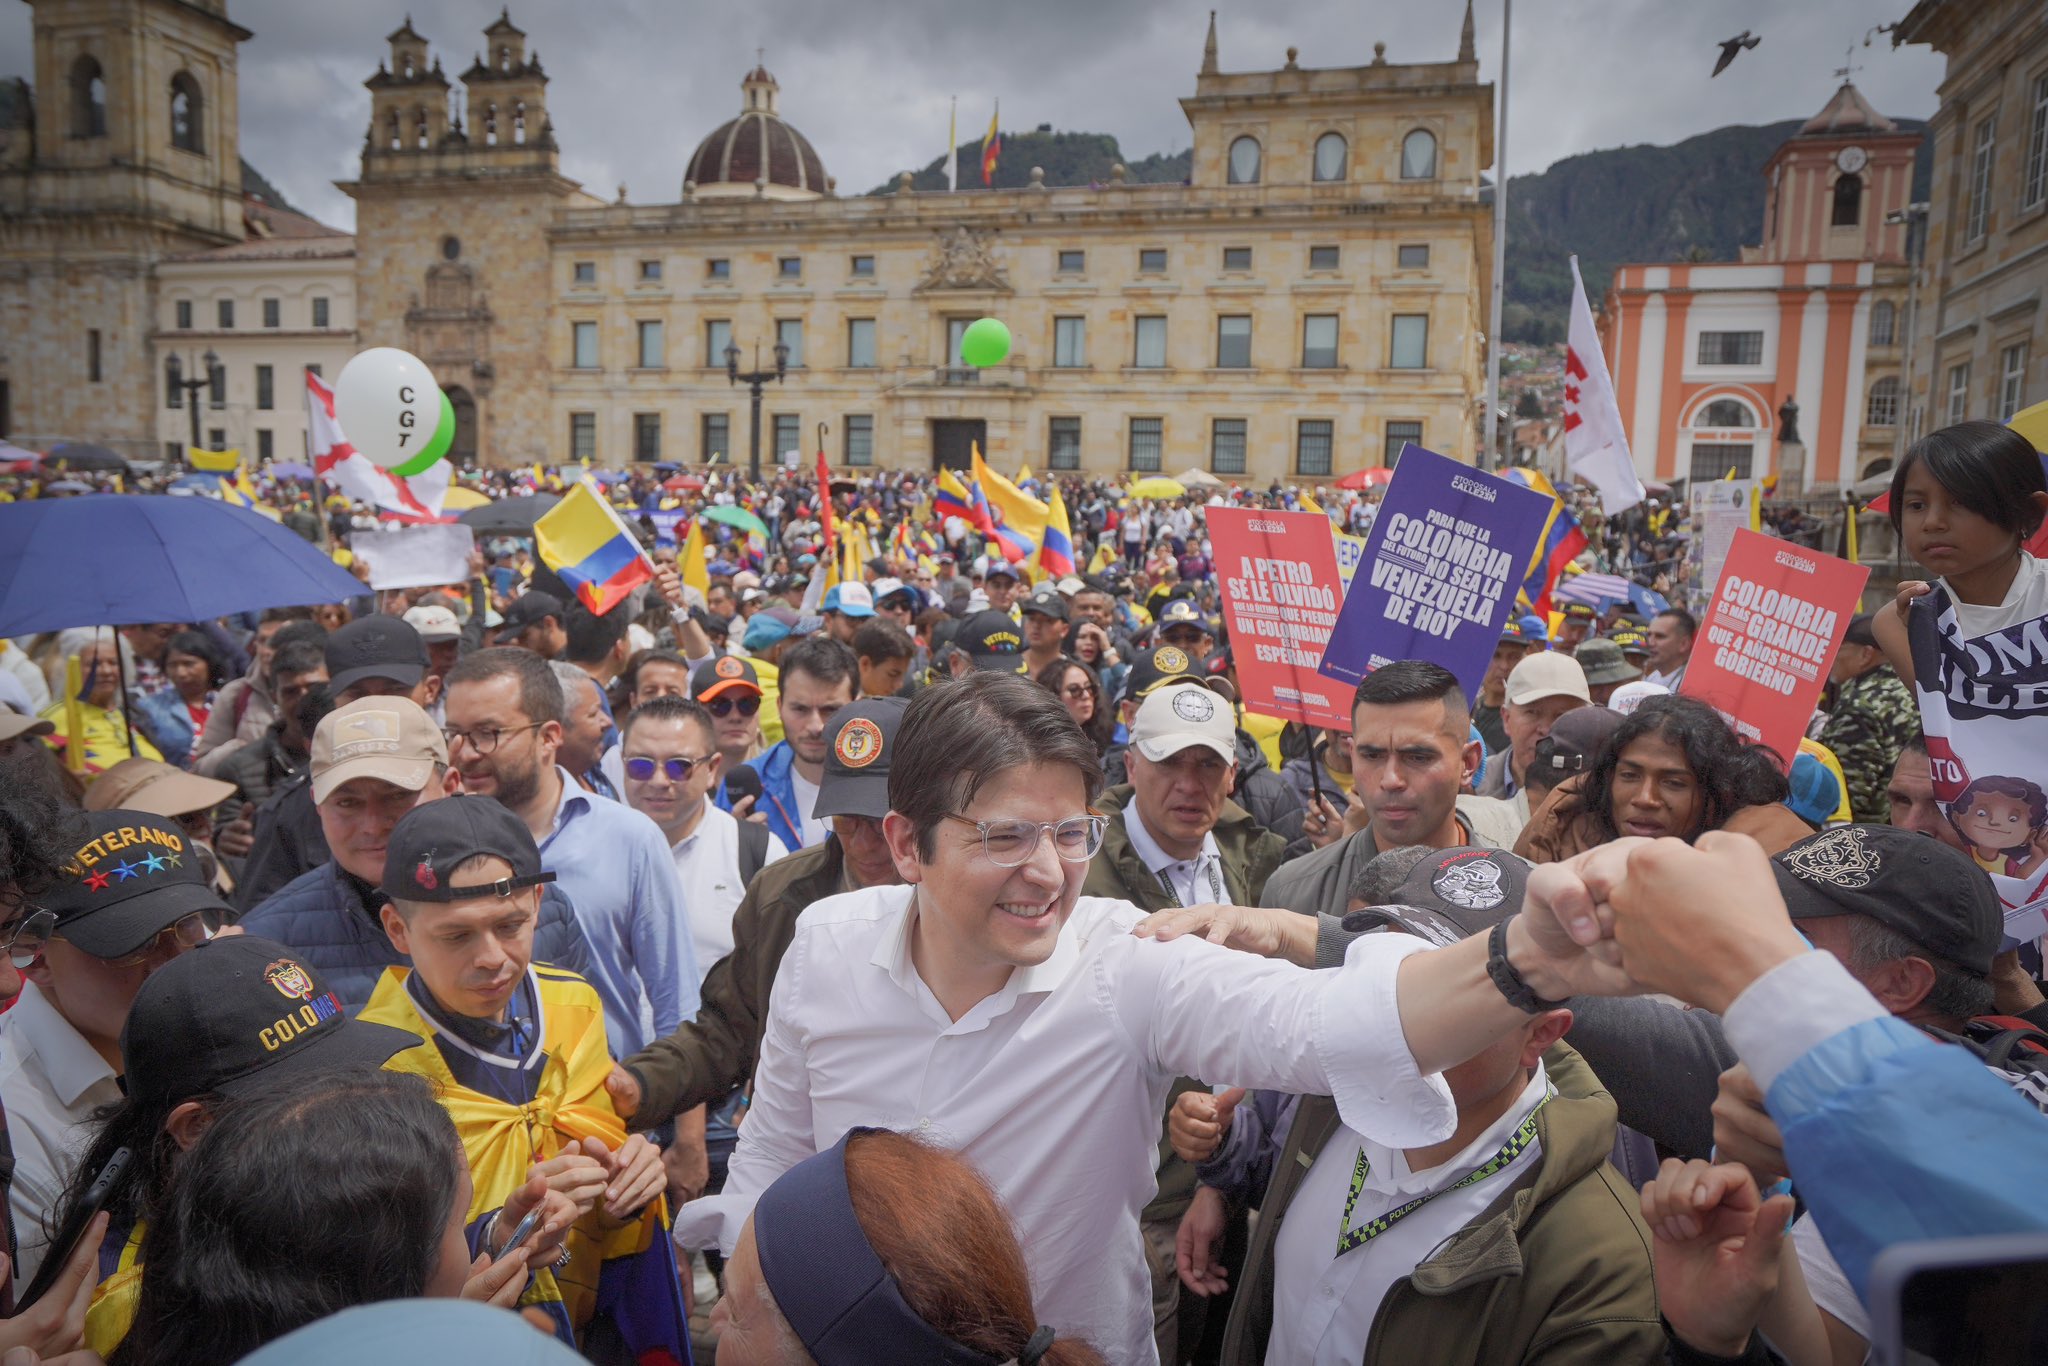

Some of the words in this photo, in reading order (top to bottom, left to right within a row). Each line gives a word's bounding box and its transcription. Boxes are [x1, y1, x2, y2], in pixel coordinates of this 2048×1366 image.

[399, 386, 415, 447] CGT
[1451, 481, 1497, 503] CALLE23N
[1453, 474, 1497, 495] #TODOSALA
[1426, 509, 1455, 530] PARA
[1455, 520, 1478, 539] QUE
[1476, 529, 1491, 544] LA
[1386, 512, 1513, 583] COLOMBIA
[1776, 550, 1816, 567] #TODOSALA
[1241, 556, 1255, 579] A
[1255, 558, 1313, 586] PETRO
[1381, 539, 1396, 553] DEL
[1396, 544, 1428, 565] FUTURO,
[1424, 556, 1450, 581] NO
[1450, 566, 1482, 594] SEA
[1481, 577, 1504, 601] LA
[1775, 555, 1816, 575] CALLE23N
[1228, 577, 1250, 600] SE
[1251, 580, 1271, 602] LE
[1272, 582, 1336, 611] OLVIDÓ
[1370, 558, 1495, 627] VENEZUELA
[1722, 575, 1838, 639] COLOMBIA
[1233, 601, 1248, 612] QUE
[1247, 603, 1255, 612] LO
[1255, 602, 1279, 615] ÚLTIMO
[1280, 607, 1300, 622] QUE
[1383, 593, 1415, 625] DE
[1413, 604, 1462, 640] HOY
[1236, 617, 1255, 635] UN
[1256, 620, 1332, 645] COLOMBIAN
[1290, 639, 1300, 649] LA
[1717, 600, 1730, 615] ES
[1729, 606, 1751, 623] MÁS
[1746, 613, 1830, 664] GRANDE
[1255, 643, 1321, 669] ESPERANZ
[1707, 625, 1734, 648] QUE
[1732, 635, 1744, 652] 4
[1742, 639, 1780, 667] AÑOS
[1780, 653, 1791, 664] DE
[1791, 657, 1803, 668] UN
[1802, 662, 1819, 676] MAL
[1714, 647, 1797, 696] GOBIERNO
[259, 991, 345, 1052] COLOMBI
[1389, 1199, 1422, 1222] POLICIA
